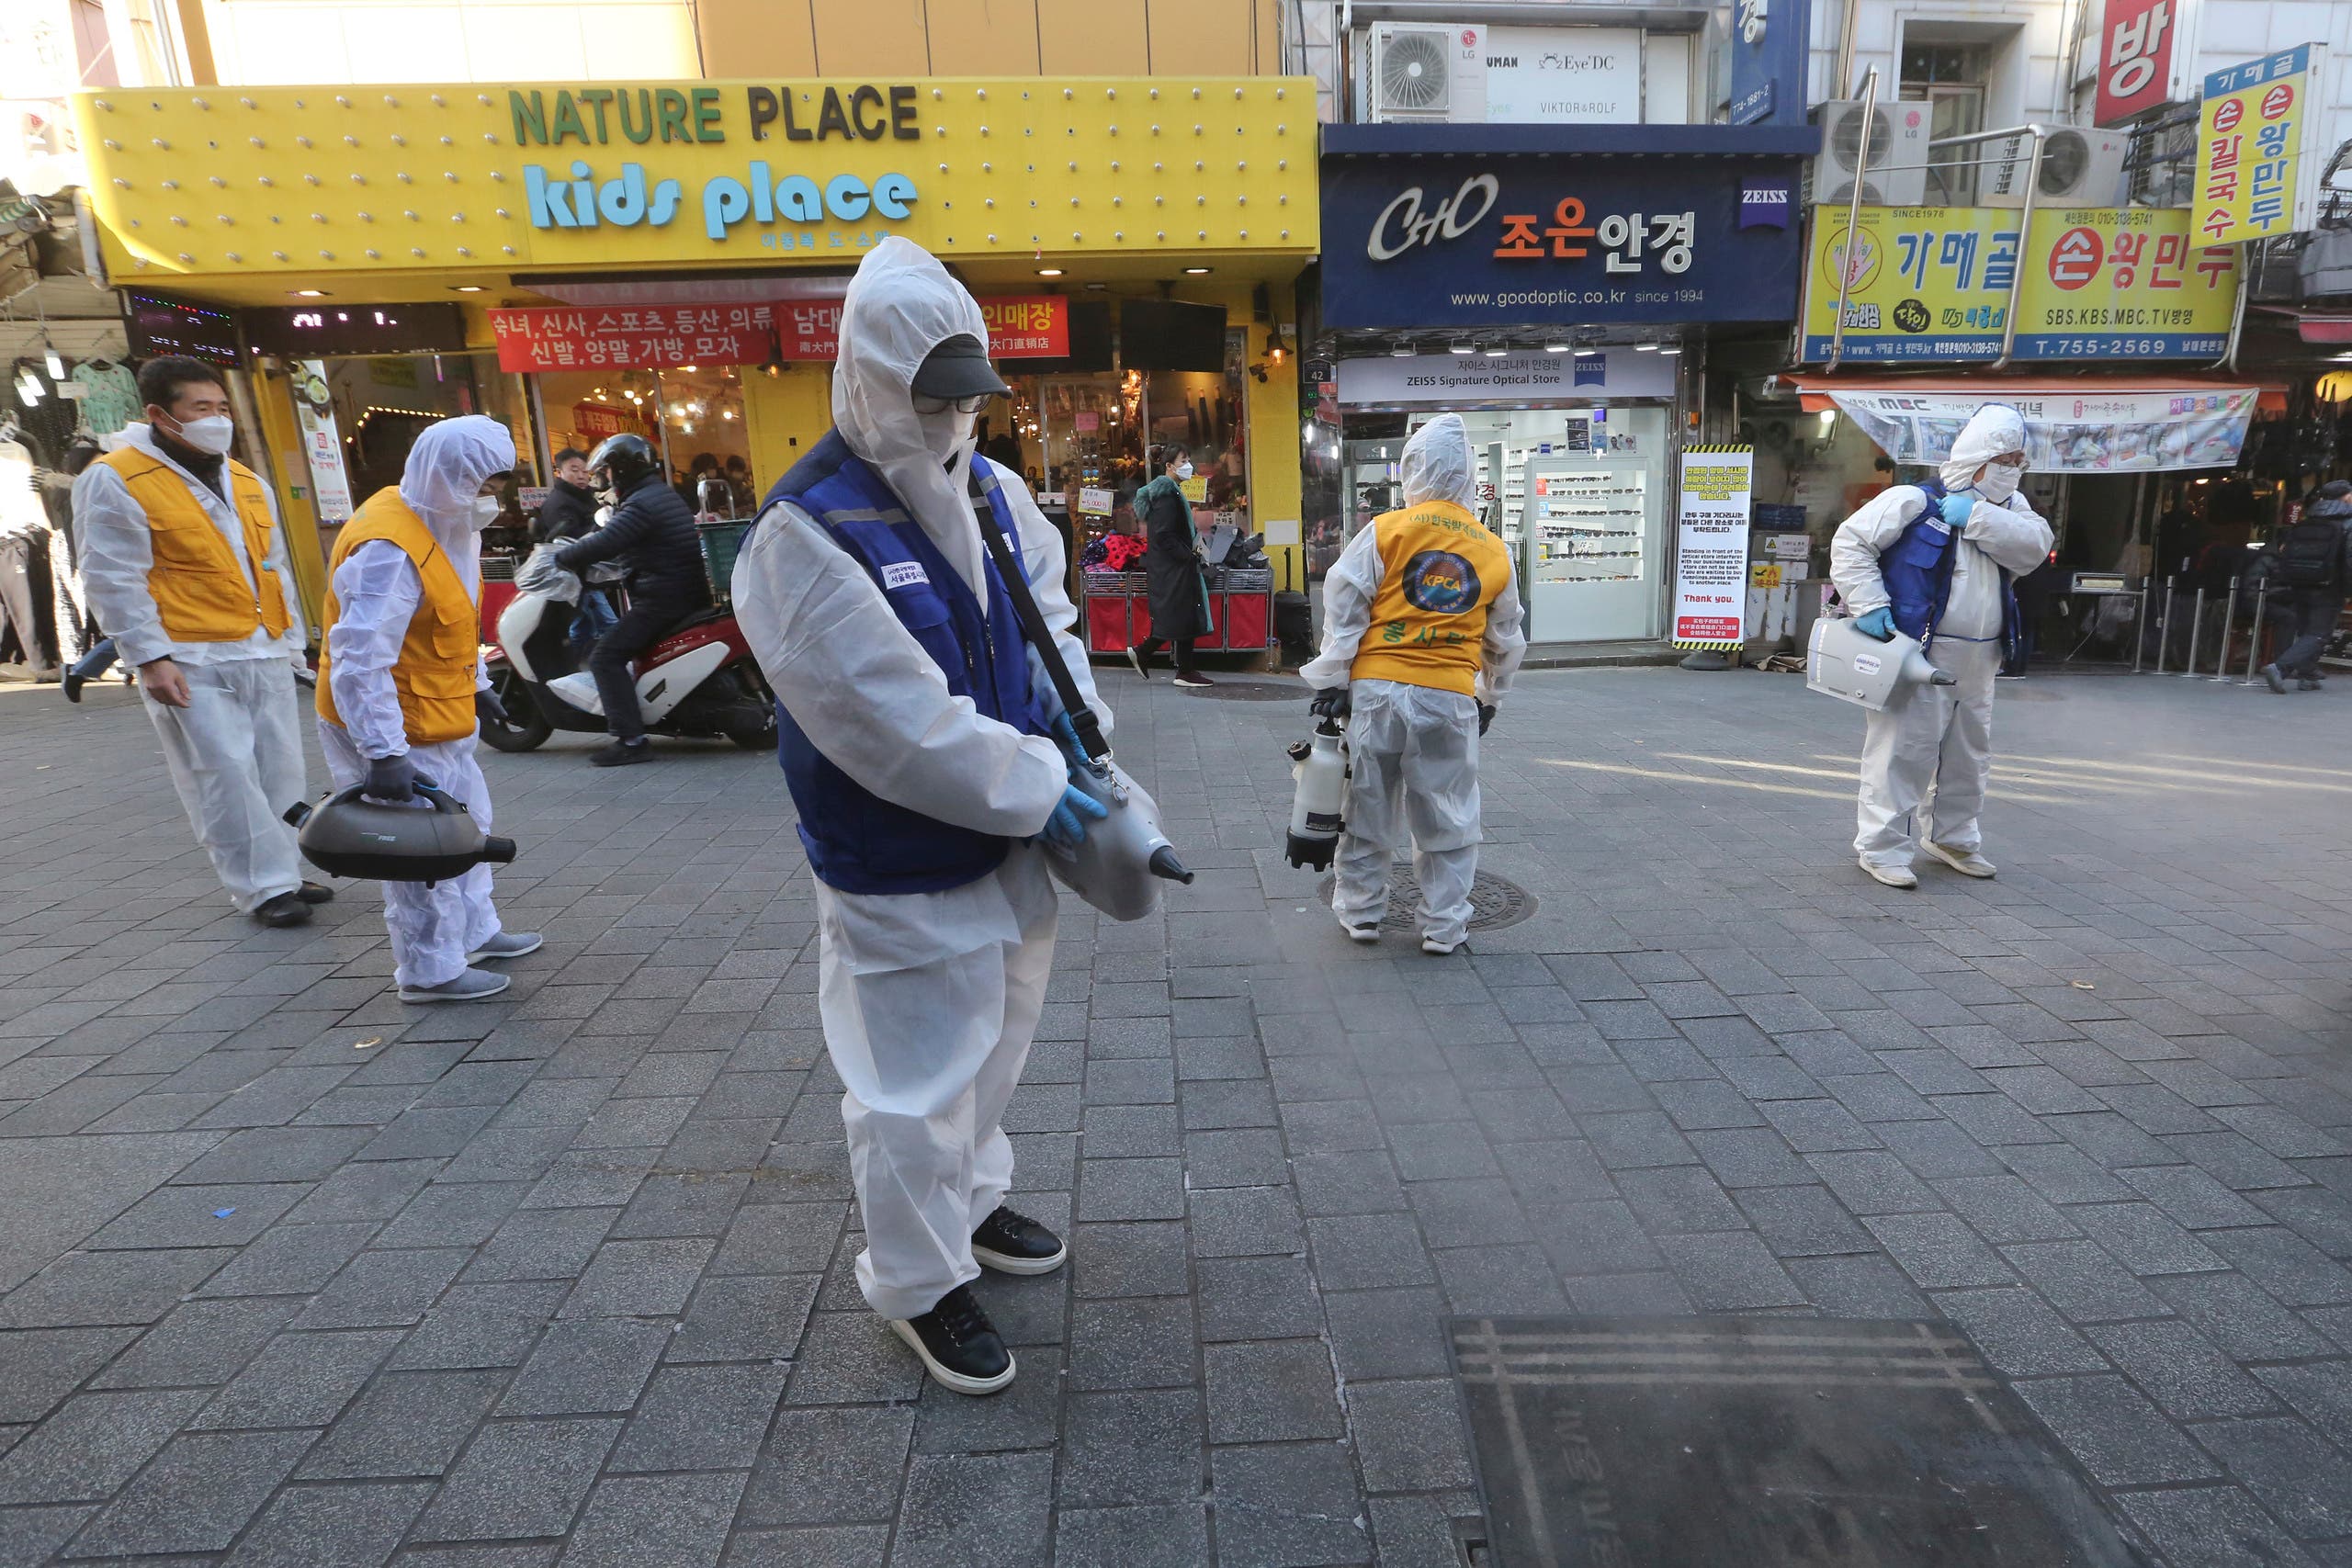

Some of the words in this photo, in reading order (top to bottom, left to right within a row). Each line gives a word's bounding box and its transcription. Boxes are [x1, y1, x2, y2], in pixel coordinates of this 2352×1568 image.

[1462, 51, 1475, 59] LG
[2109, 5, 2170, 98] 방
[1487, 57, 1518, 68] UMAN
[1565, 55, 1614, 73] Eye'DC
[2218, 53, 2294, 90] 가메골
[508, 88, 725, 145] NATURE
[748, 85, 920, 141] PLACE
[1541, 103, 1617, 114] VIKTOR&ROLF
[523, 160, 682, 229] kids
[704, 161, 917, 241] place
[1742, 189, 1787, 204] ZEISS
[1367, 174, 1498, 261] CHO
[1493, 197, 1694, 274] 조은안경
[1897, 231, 2019, 289] 가메골
[1451, 288, 1626, 307] www.goodoptic.co.kr
[1635, 289, 1669, 302] since
[1674, 289, 1704, 302] 1994
[794, 307, 840, 334] 남대
[983, 301, 1054, 332] 인매장
[799, 341, 839, 354] 南大門
[989, 337, 1048, 350] 大门直销店
[2036, 340, 2165, 355] T.755-2569
[1458, 359, 1487, 371] 자이스
[1490, 359, 1529, 371] 시그니처
[1532, 358, 1561, 370] 안경원
[1575, 362, 1605, 372] ZEISS
[1311, 371, 1324, 380] 42
[1407, 376, 1436, 387] ZEISS
[1440, 375, 1490, 388] Signature
[1493, 374, 1529, 387] Optical
[1532, 373, 1560, 385] Store
[1879, 398, 1930, 411] MBC
[1475, 484, 1495, 501] 경
[1422, 574, 1461, 592] KPCA
[1684, 594, 1712, 603] Thank
[1715, 595, 1734, 604] you.
